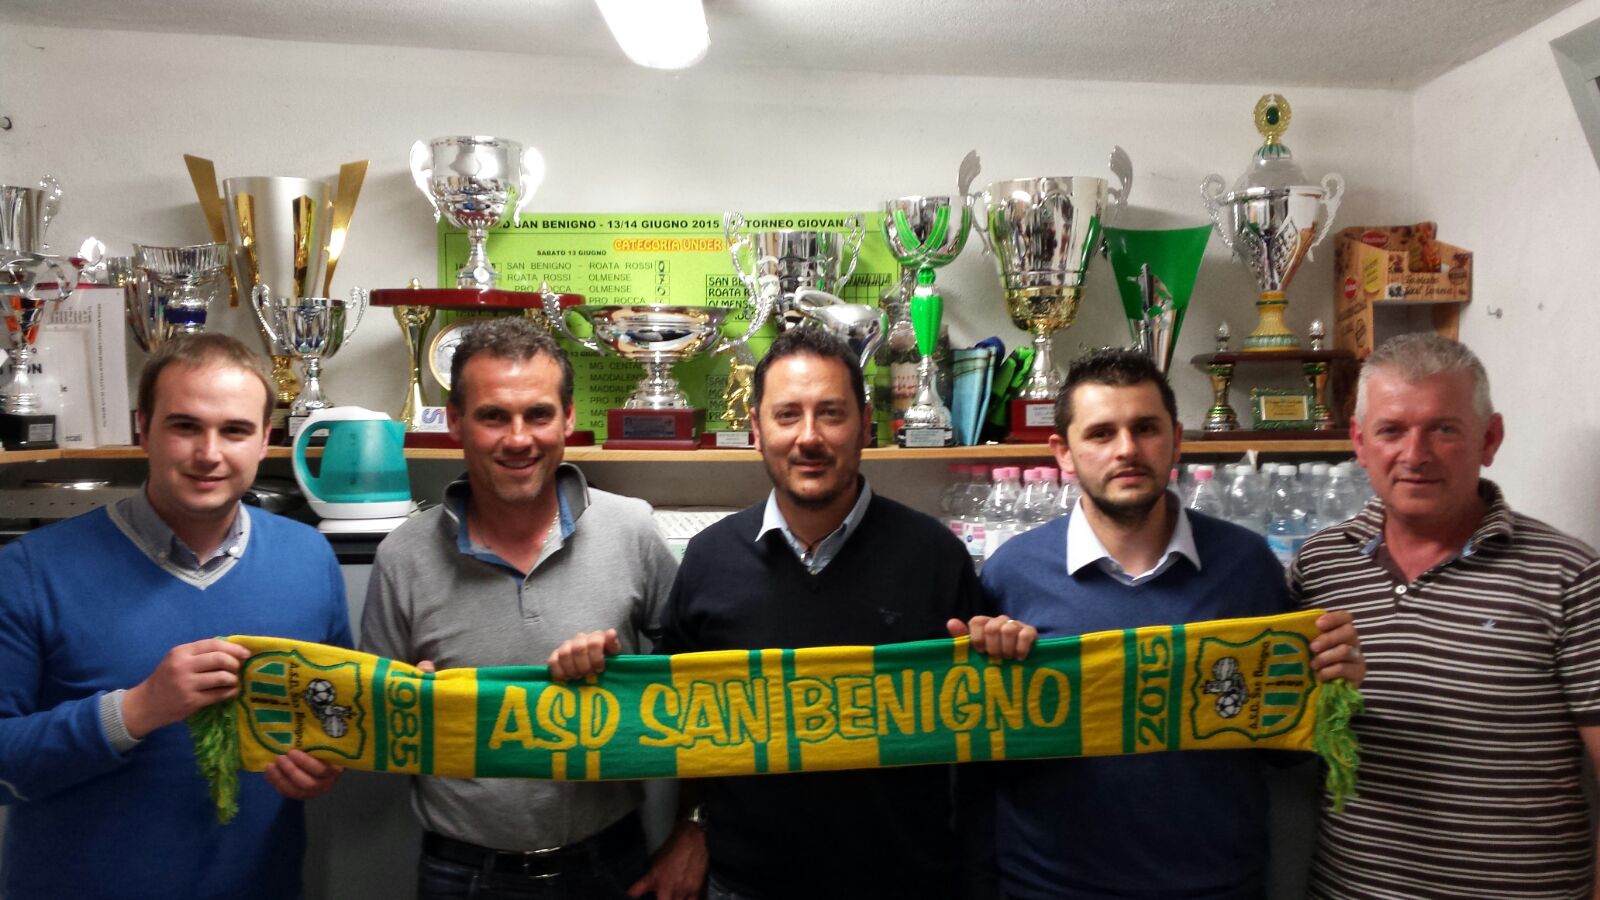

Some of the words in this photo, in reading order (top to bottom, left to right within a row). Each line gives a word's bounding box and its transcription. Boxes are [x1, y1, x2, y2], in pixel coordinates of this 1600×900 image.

[514, 220, 538, 229] AN
[542, 220, 597, 229] BENIGNO
[607, 220, 638, 229] 13/14
[641, 220, 689, 229] GIUGNO
[692, 220, 720, 229] 2015
[745, 219, 794, 228] TORNEO
[797, 219, 862, 228] GIOVAN
[613, 239, 681, 251] CATEGORIA
[683, 239, 722, 251] UNDER
[506, 262, 525, 270] SAN
[530, 262, 572, 270] BENIGNO
[589, 261, 620, 270] ROATA
[625, 261, 653, 270] ROSSI
[507, 273, 538, 281] ROATA
[543, 273, 572, 281] ROSSI
[588, 273, 632, 281] OLMENSE
[708, 277, 729, 286] SAN
[514, 285, 534, 293] PRO
[588, 285, 632, 293] OLMENSE
[708, 288, 742, 297] ROATA
[708, 300, 754, 309] OLMENS
[1137, 635, 1170, 746] 2015
[487, 683, 621, 751] ASD
[638, 676, 770, 750] SAN
[788, 664, 1072, 747] BENIGNO
[387, 669, 420, 768] 1985
